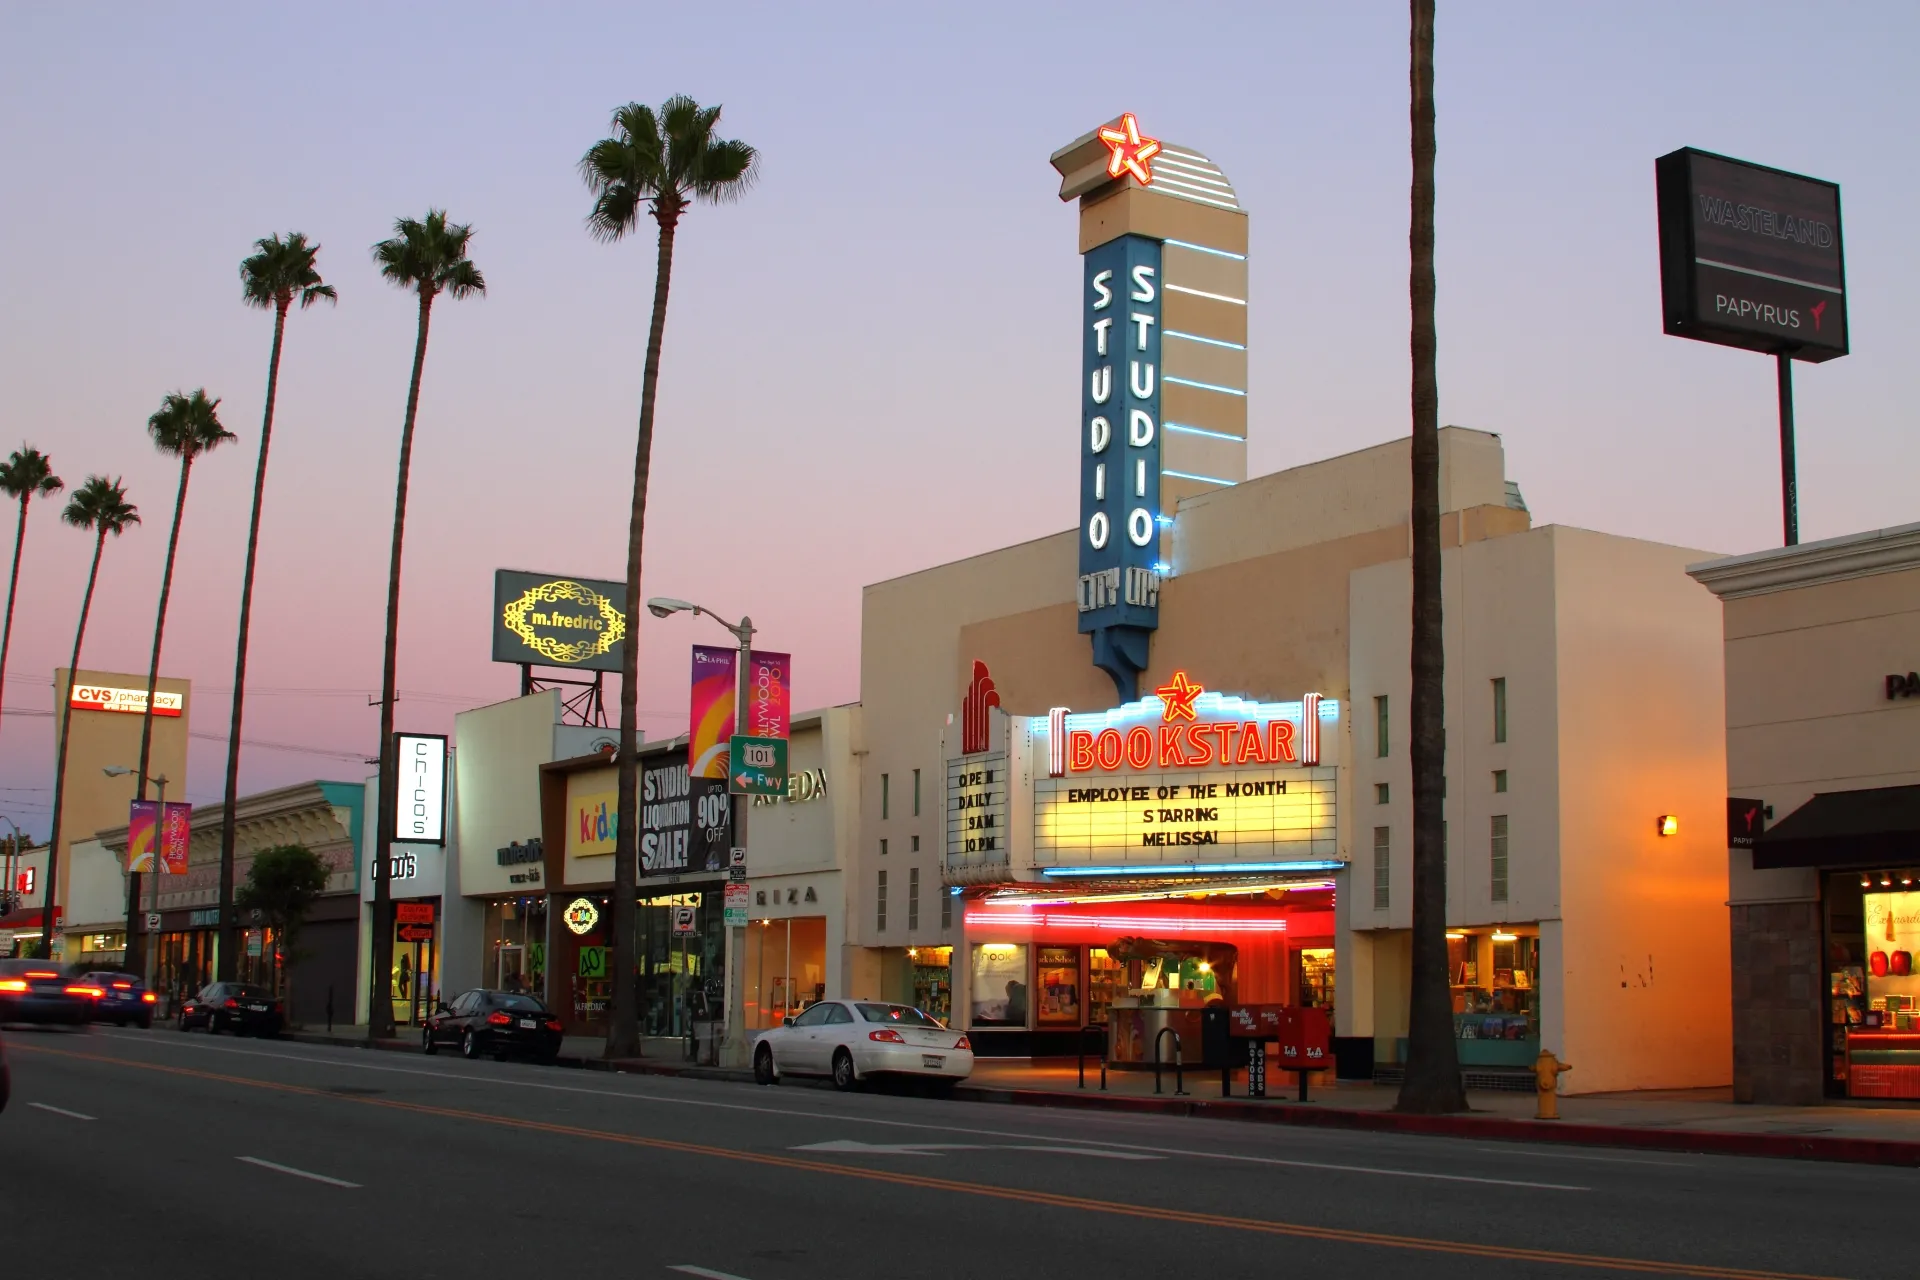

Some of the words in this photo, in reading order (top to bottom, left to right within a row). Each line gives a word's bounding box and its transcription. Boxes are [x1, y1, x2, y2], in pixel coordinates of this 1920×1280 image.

[1700, 195, 1833, 248] WASTELAND
[1716, 294, 1801, 329] PAPYRUS
[1088, 269, 1112, 551] STUDIO
[1126, 265, 1155, 547] STUDIO
[531, 611, 603, 631] m.fredric
[78, 688, 176, 707] CVS/pharacy
[758, 666, 770, 738] LLYWOOD
[750, 750, 769, 763] 101
[1069, 720, 1298, 772] BOOKSTAR
[644, 764, 690, 802] STUDIO
[757, 774, 782, 790] Fwy
[958, 769, 994, 788] OPEN
[1068, 785, 1150, 803] EMPLOYEE
[1157, 785, 1180, 800] OF
[1188, 784, 1218, 799] THE
[1226, 780, 1288, 798] MONTH
[697, 793, 730, 829] 90%
[958, 791, 992, 810] DAILY
[580, 801, 619, 844] kids
[643, 800, 690, 831] LIQUIDATION
[1143, 807, 1219, 824] STARRING
[169, 810, 179, 860] HOLLYWOOD
[706, 827, 724, 843] OFF
[641, 829, 689, 871] SALE!
[756, 886, 818, 906] RIZA
[981, 952, 1012, 961] nook
[1284, 1046, 1297, 1056] LA
[1306, 1047, 1323, 1057] LA
[1257, 1058, 1265, 1091] JOBS
